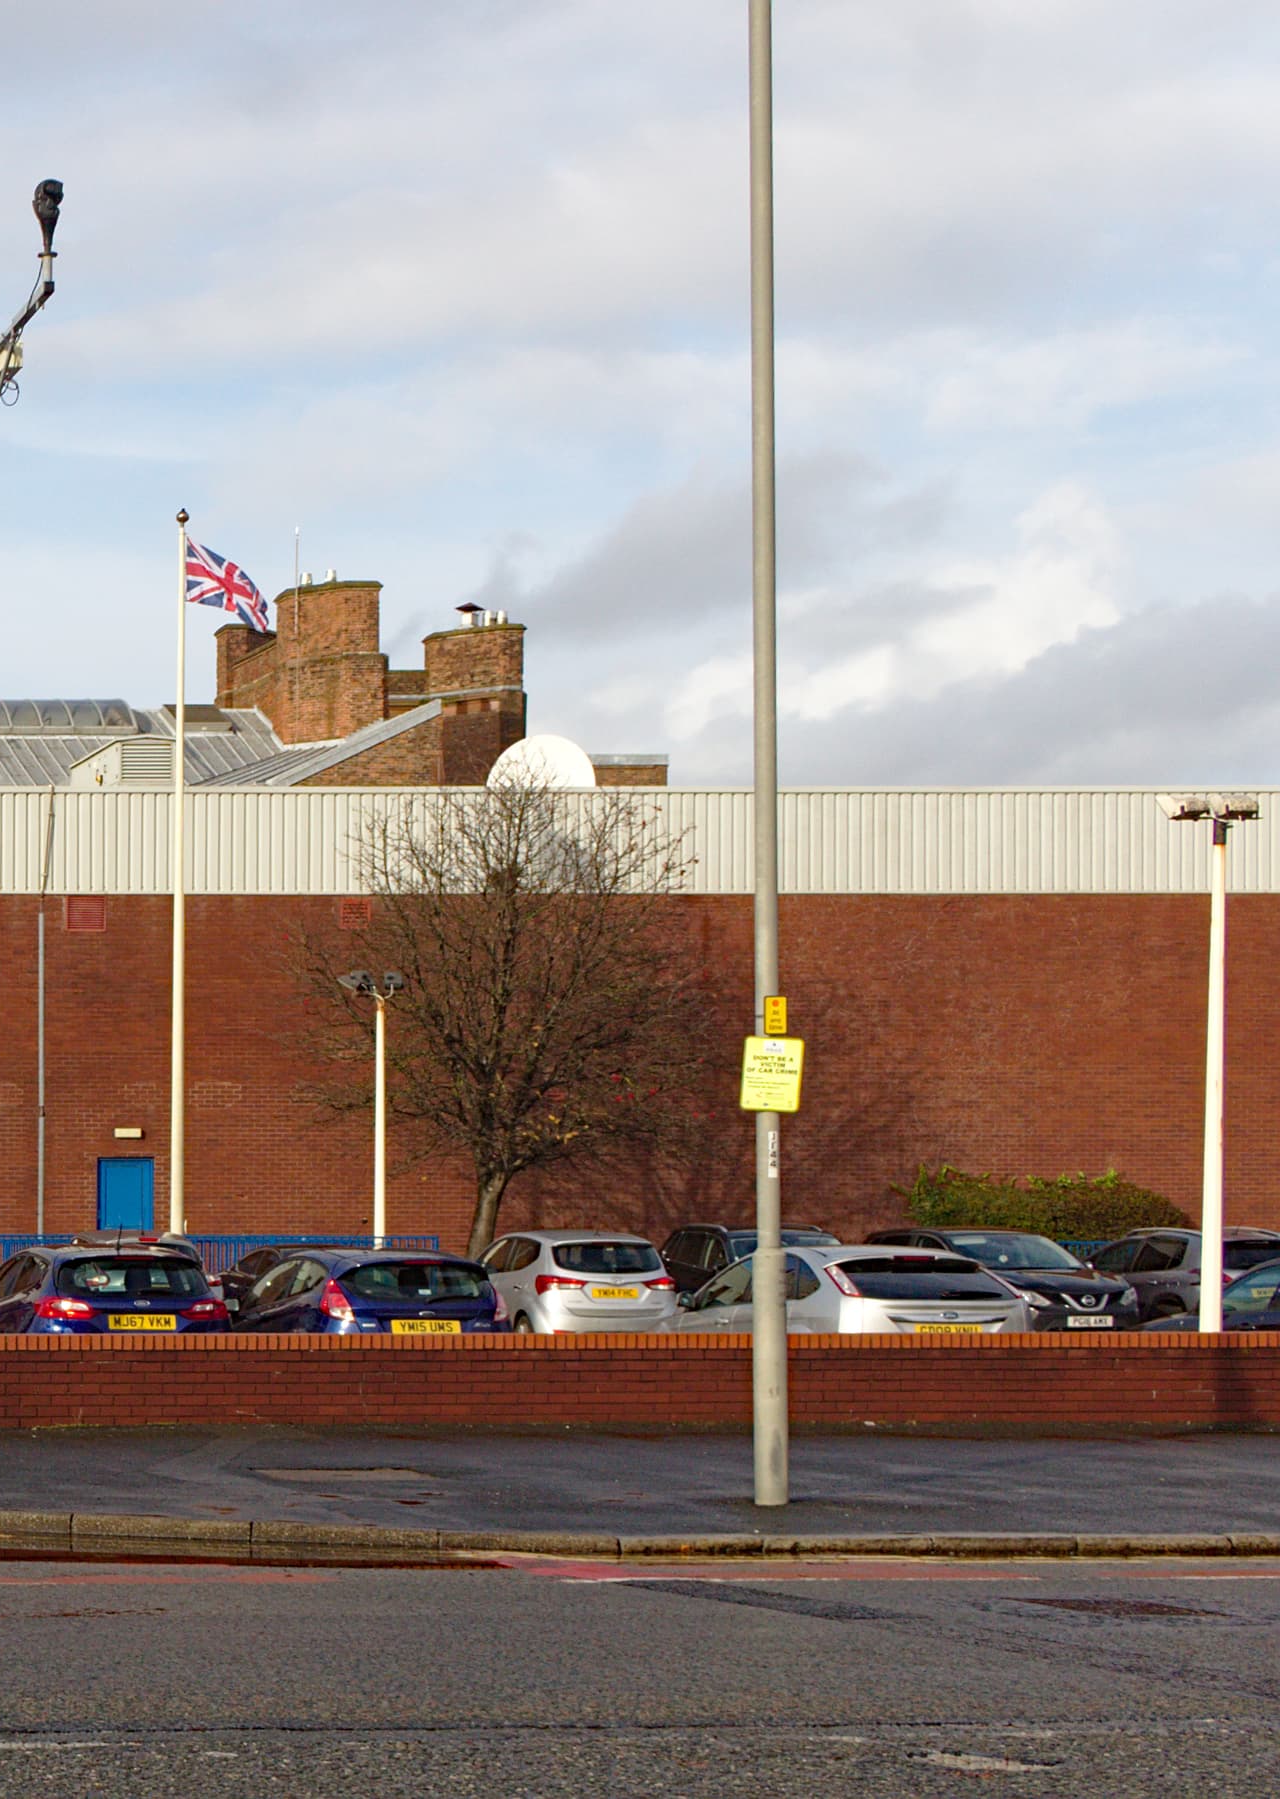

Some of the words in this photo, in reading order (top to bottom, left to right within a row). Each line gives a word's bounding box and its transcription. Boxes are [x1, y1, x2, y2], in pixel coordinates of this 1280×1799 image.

[775, 1068, 798, 1076] CRIME
[113, 1316, 144, 1328] MJ67
[148, 1316, 172, 1328] VKM
[399, 1321, 427, 1332] YM15
[430, 1321, 454, 1333] UMS
